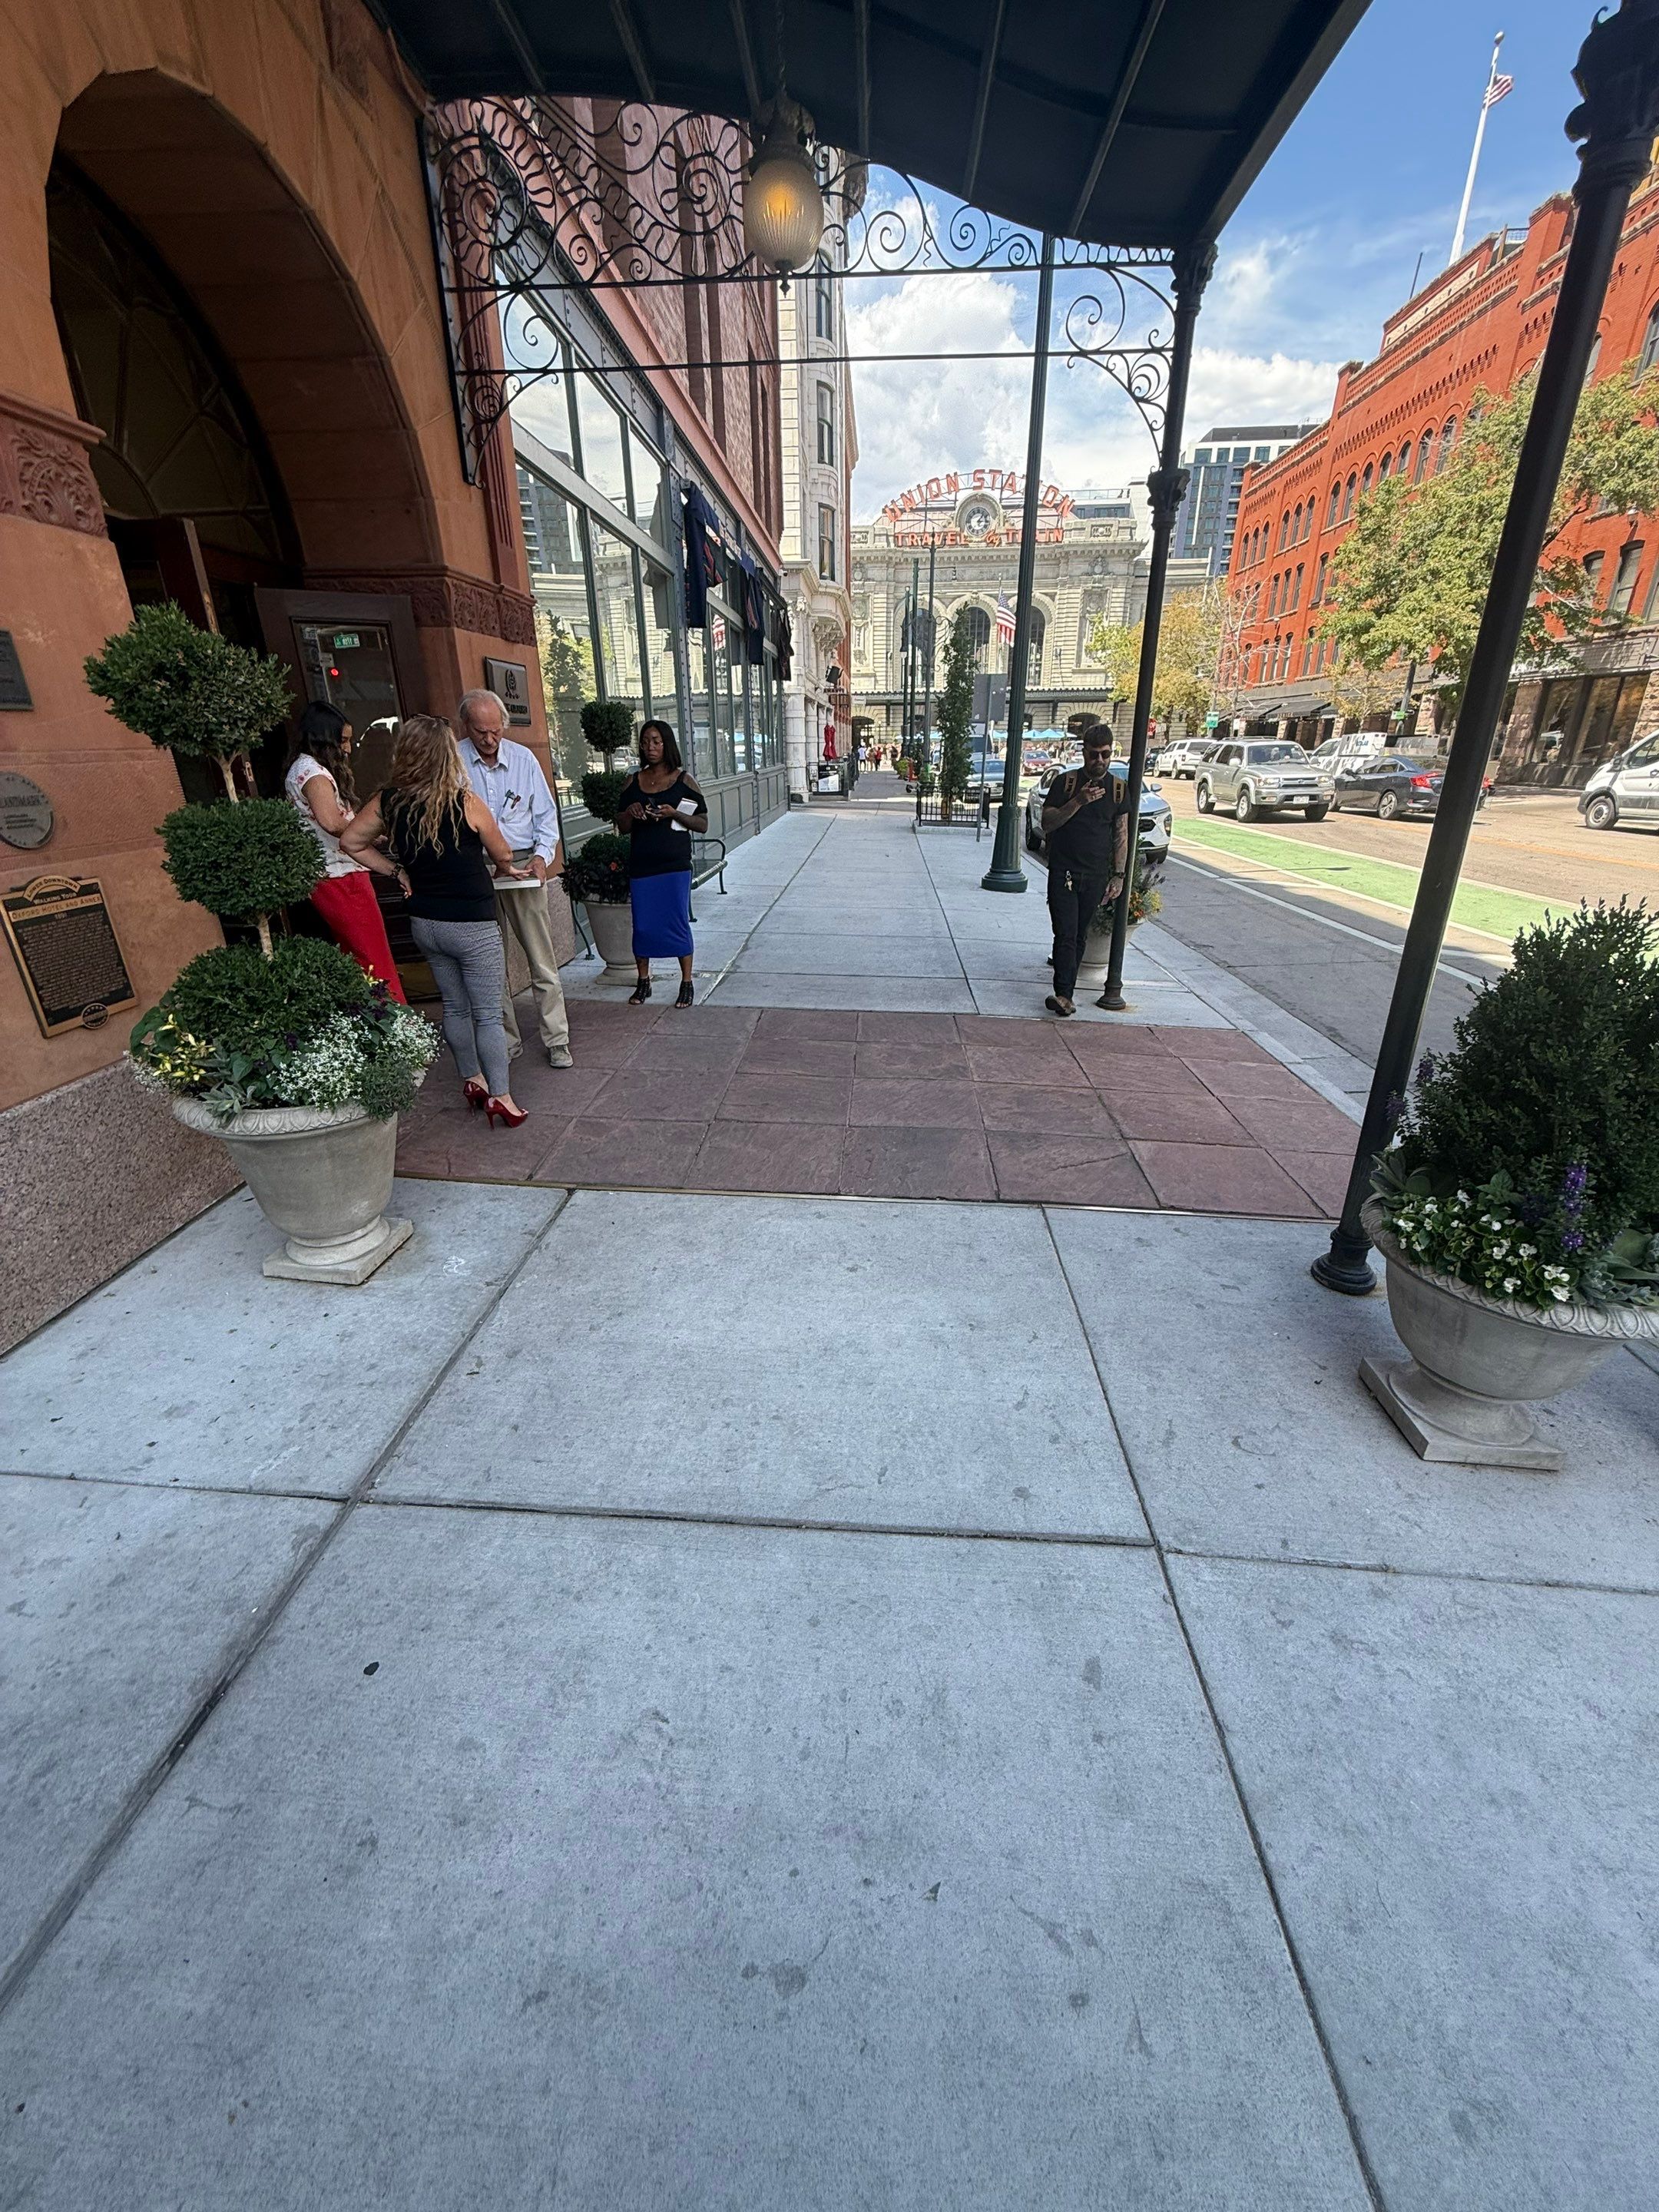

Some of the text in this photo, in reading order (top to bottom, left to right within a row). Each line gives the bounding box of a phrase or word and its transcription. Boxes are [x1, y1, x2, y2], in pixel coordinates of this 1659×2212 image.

[884, 469, 1076, 523] UNION STAON
[895, 528, 1064, 548] TRAVEL by TIN
[41, 904, 63, 912] HOTEL
[80, 896, 101, 905] ANNEX
